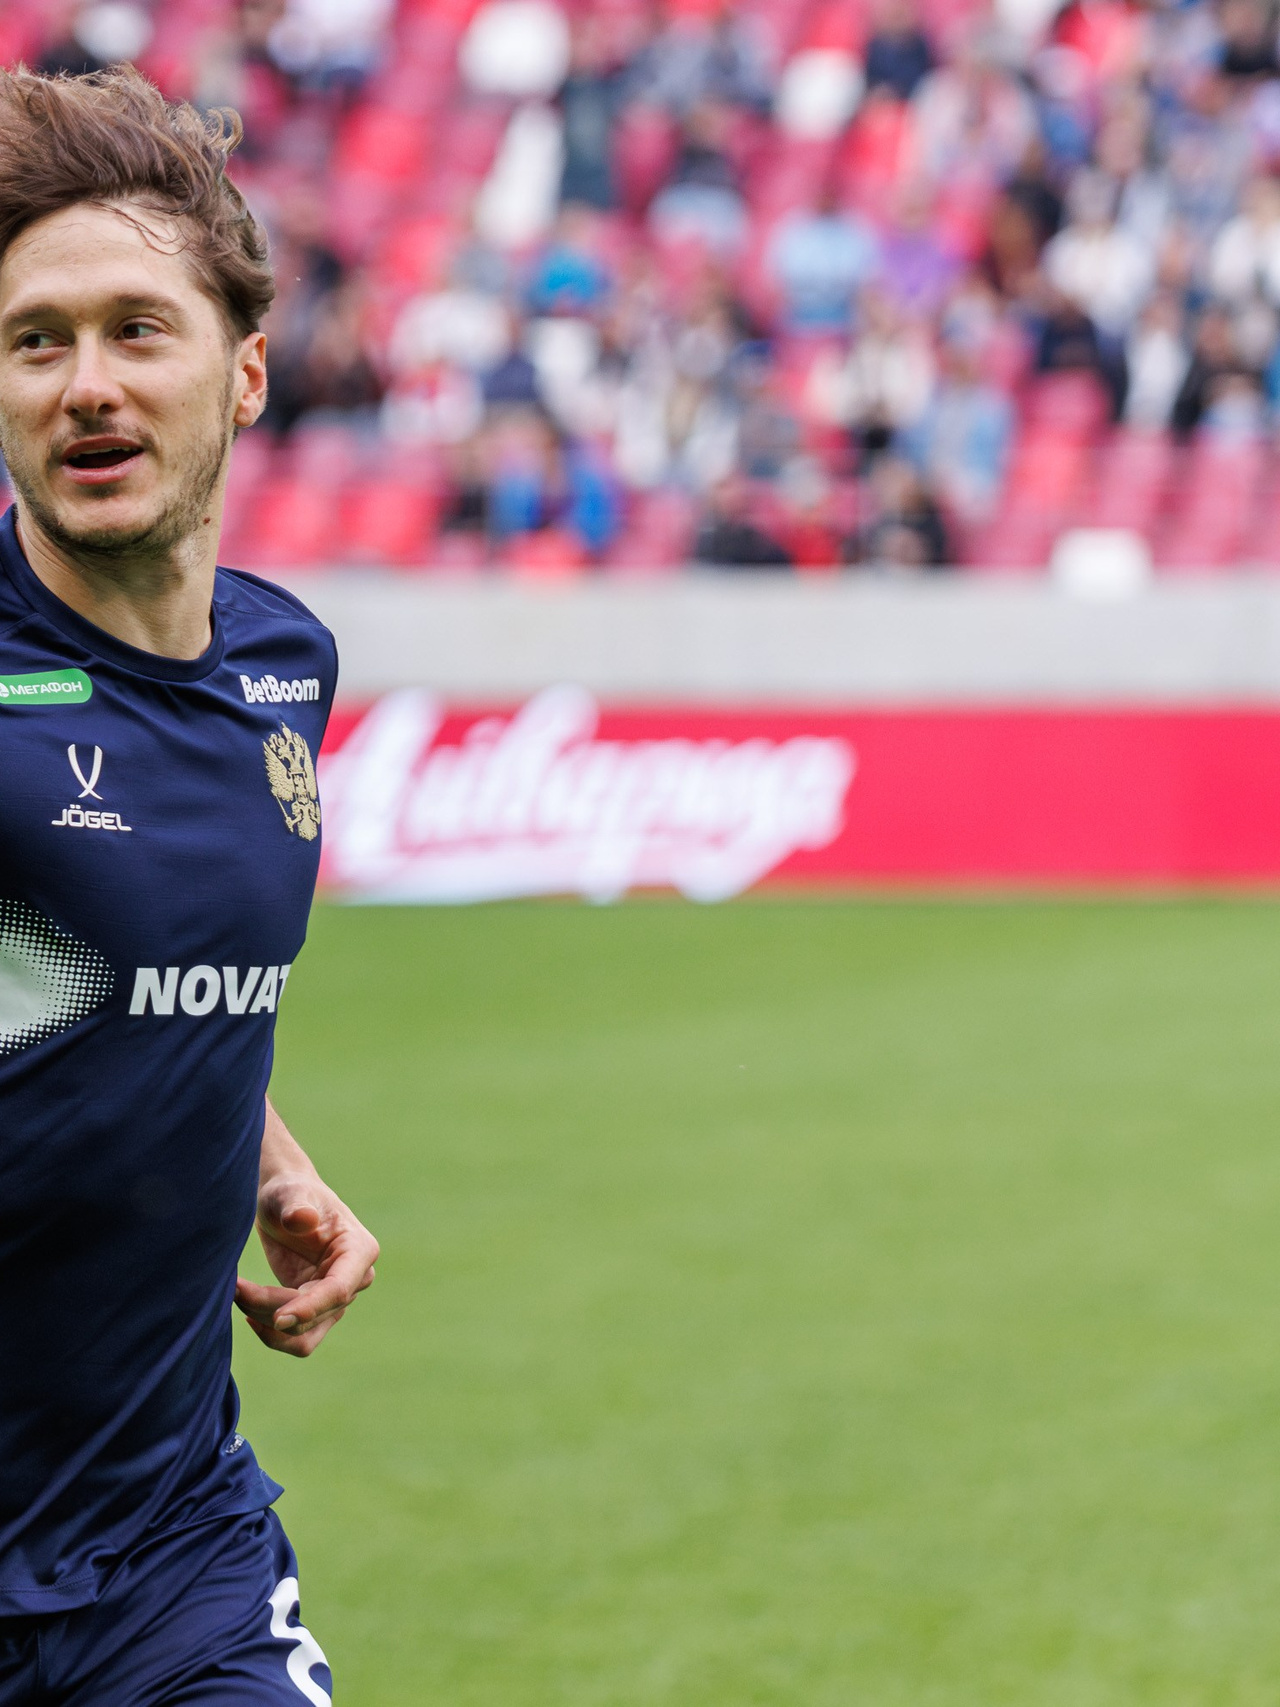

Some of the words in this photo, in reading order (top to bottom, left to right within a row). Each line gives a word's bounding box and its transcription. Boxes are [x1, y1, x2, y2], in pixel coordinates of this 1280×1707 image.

[9, 681, 83, 696] МЕГАФОН
[239, 674, 320, 704] BetBoom
[51, 803, 133, 832] JÖGEL
